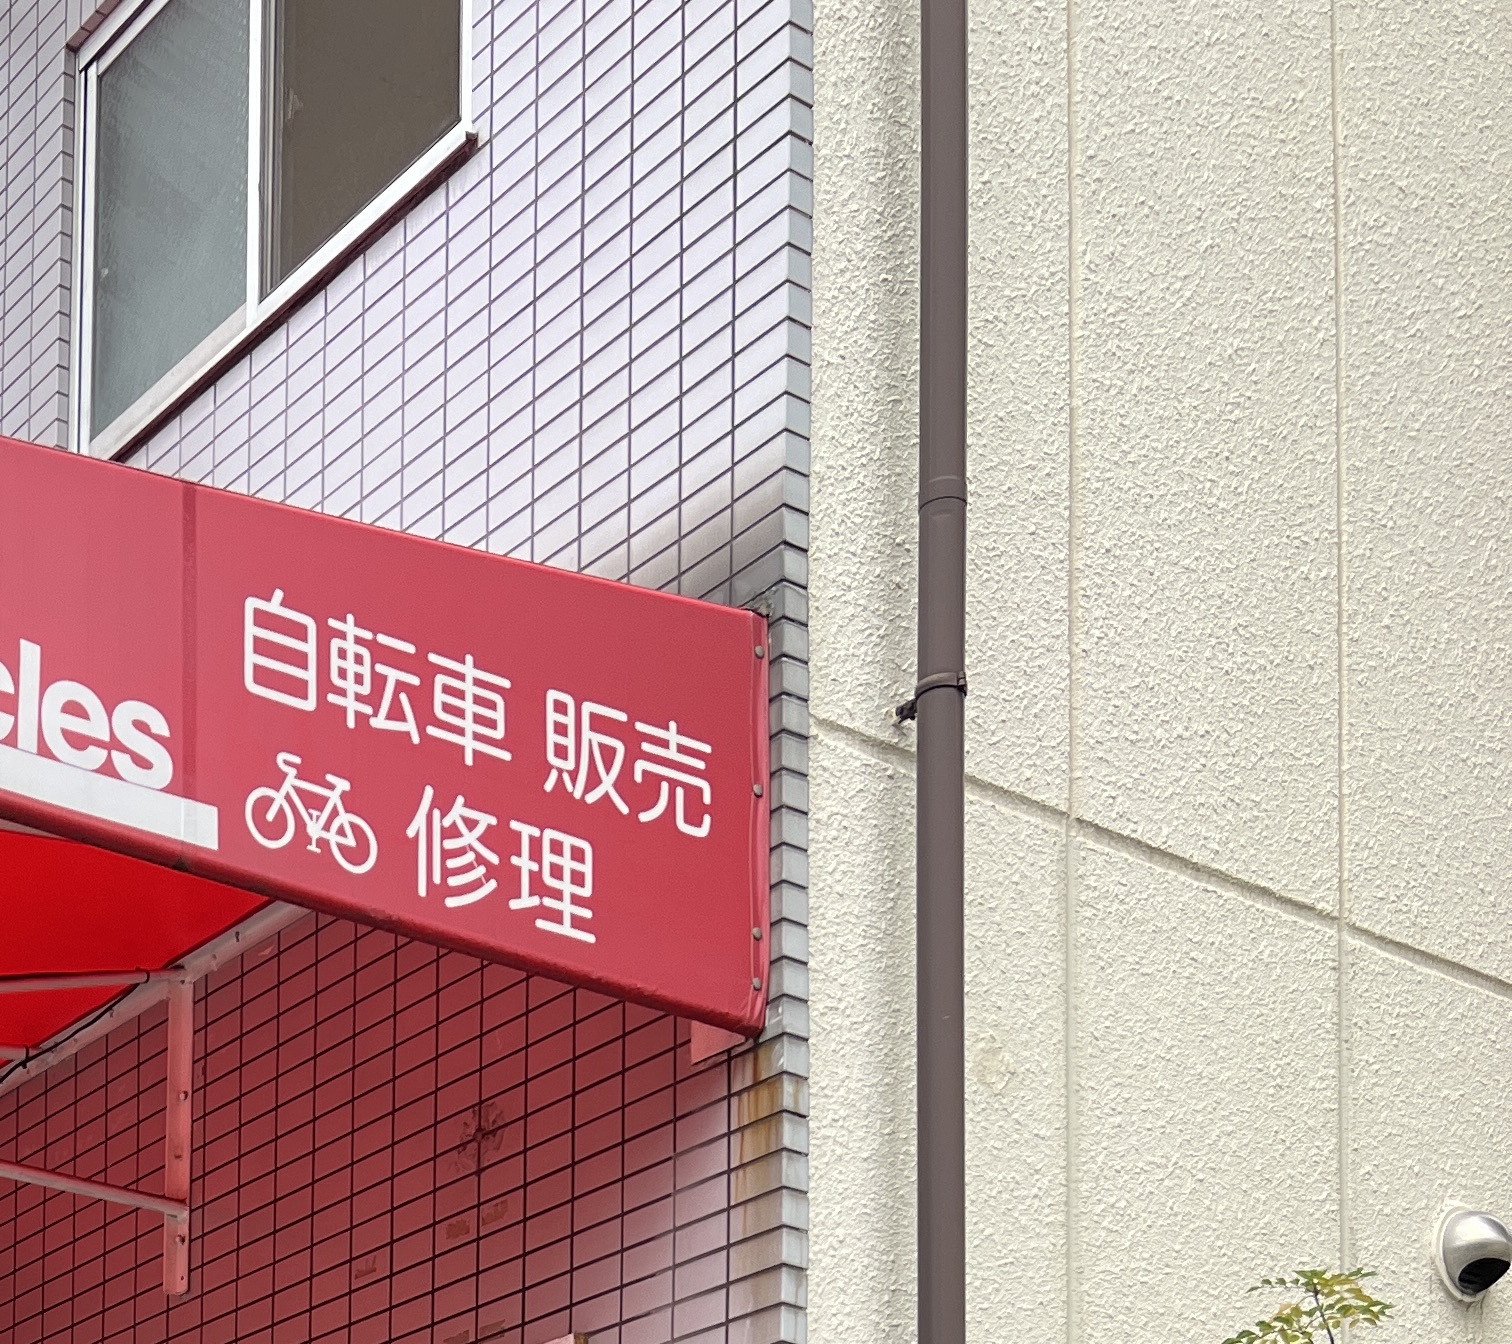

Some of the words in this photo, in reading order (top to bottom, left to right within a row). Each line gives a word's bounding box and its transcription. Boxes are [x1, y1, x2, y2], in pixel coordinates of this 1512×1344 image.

[244, 588, 513, 767] 自転車
[543, 688, 713, 838] 販売
[405, 784, 597, 944] 修理
